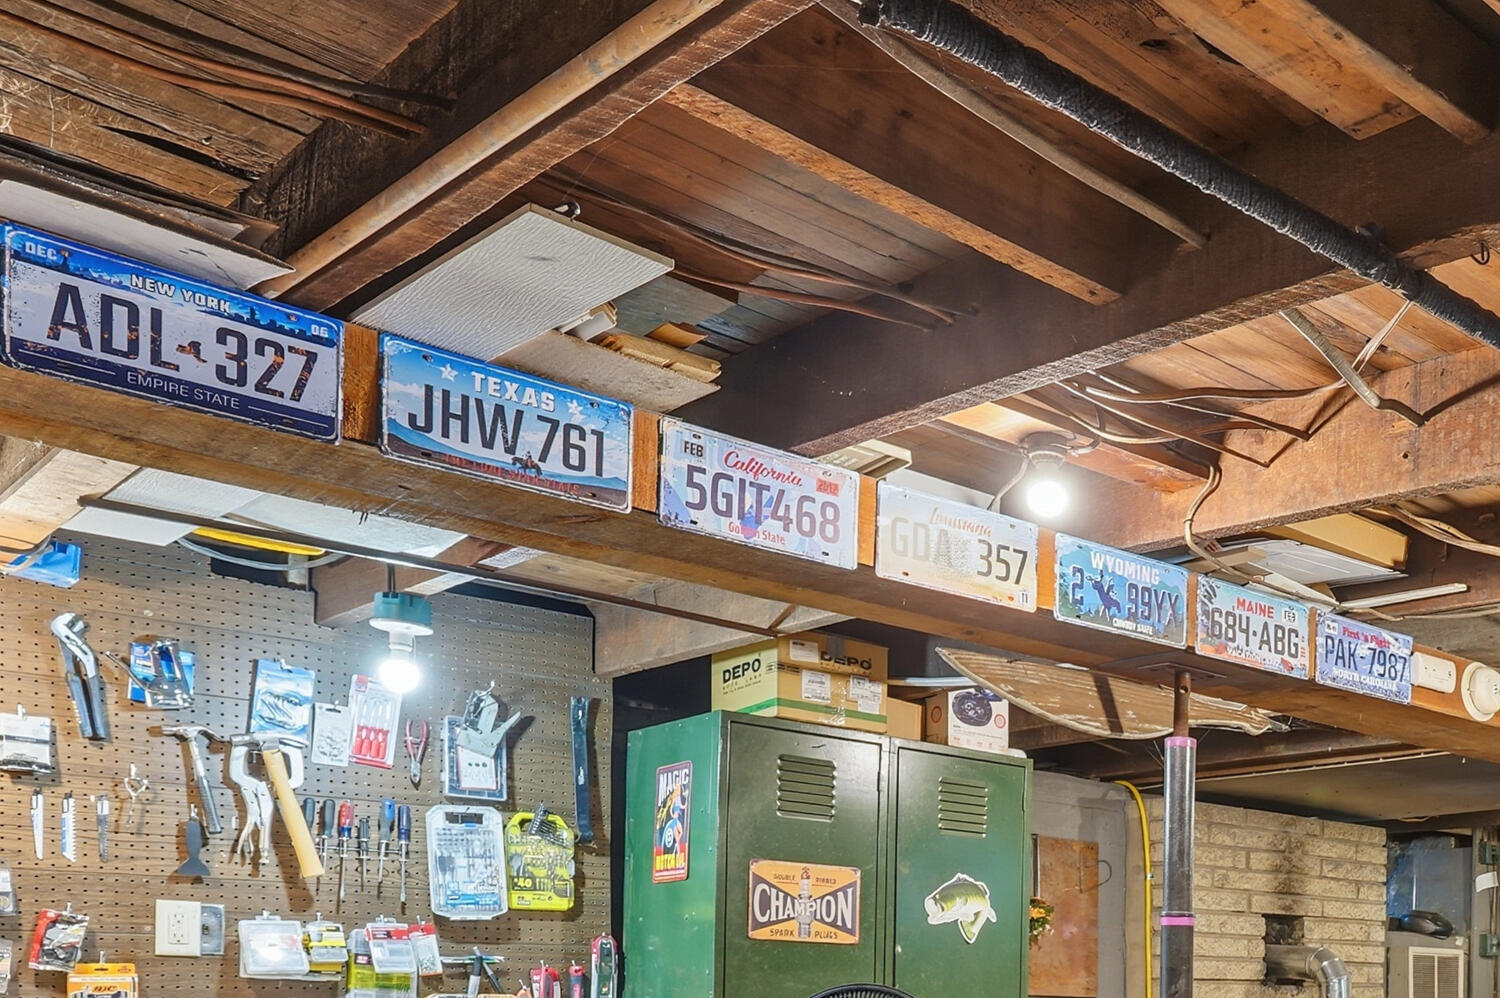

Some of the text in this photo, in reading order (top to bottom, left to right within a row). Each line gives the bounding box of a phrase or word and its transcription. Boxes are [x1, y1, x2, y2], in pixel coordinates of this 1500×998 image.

[25, 241, 57, 260] DEC
[131, 274, 231, 313] NEW YORK
[46, 282, 318, 401] ADL 327
[311, 324, 328, 338] 06
[127, 372, 240, 410] EMPIRE STATE
[471, 371, 555, 412] TEXAS
[408, 384, 604, 477] JHW 761
[684, 441, 704, 458] FEB
[723, 450, 803, 488] California
[685, 464, 840, 544] 5GIT468
[728, 521, 786, 545] Gon State
[977, 538, 1028, 584] 357
[1090, 551, 1160, 585] WYOMING
[1071, 566, 1084, 605] 2
[1236, 597, 1274, 619] MAINE
[722, 658, 761, 684] DEPO
[1325, 635, 1407, 682] PAK-7987
[658, 768, 689, 807] MAGIC
[753, 883, 854, 929] CHAMPION
[769, 928, 838, 939] SPARK PLUGS
